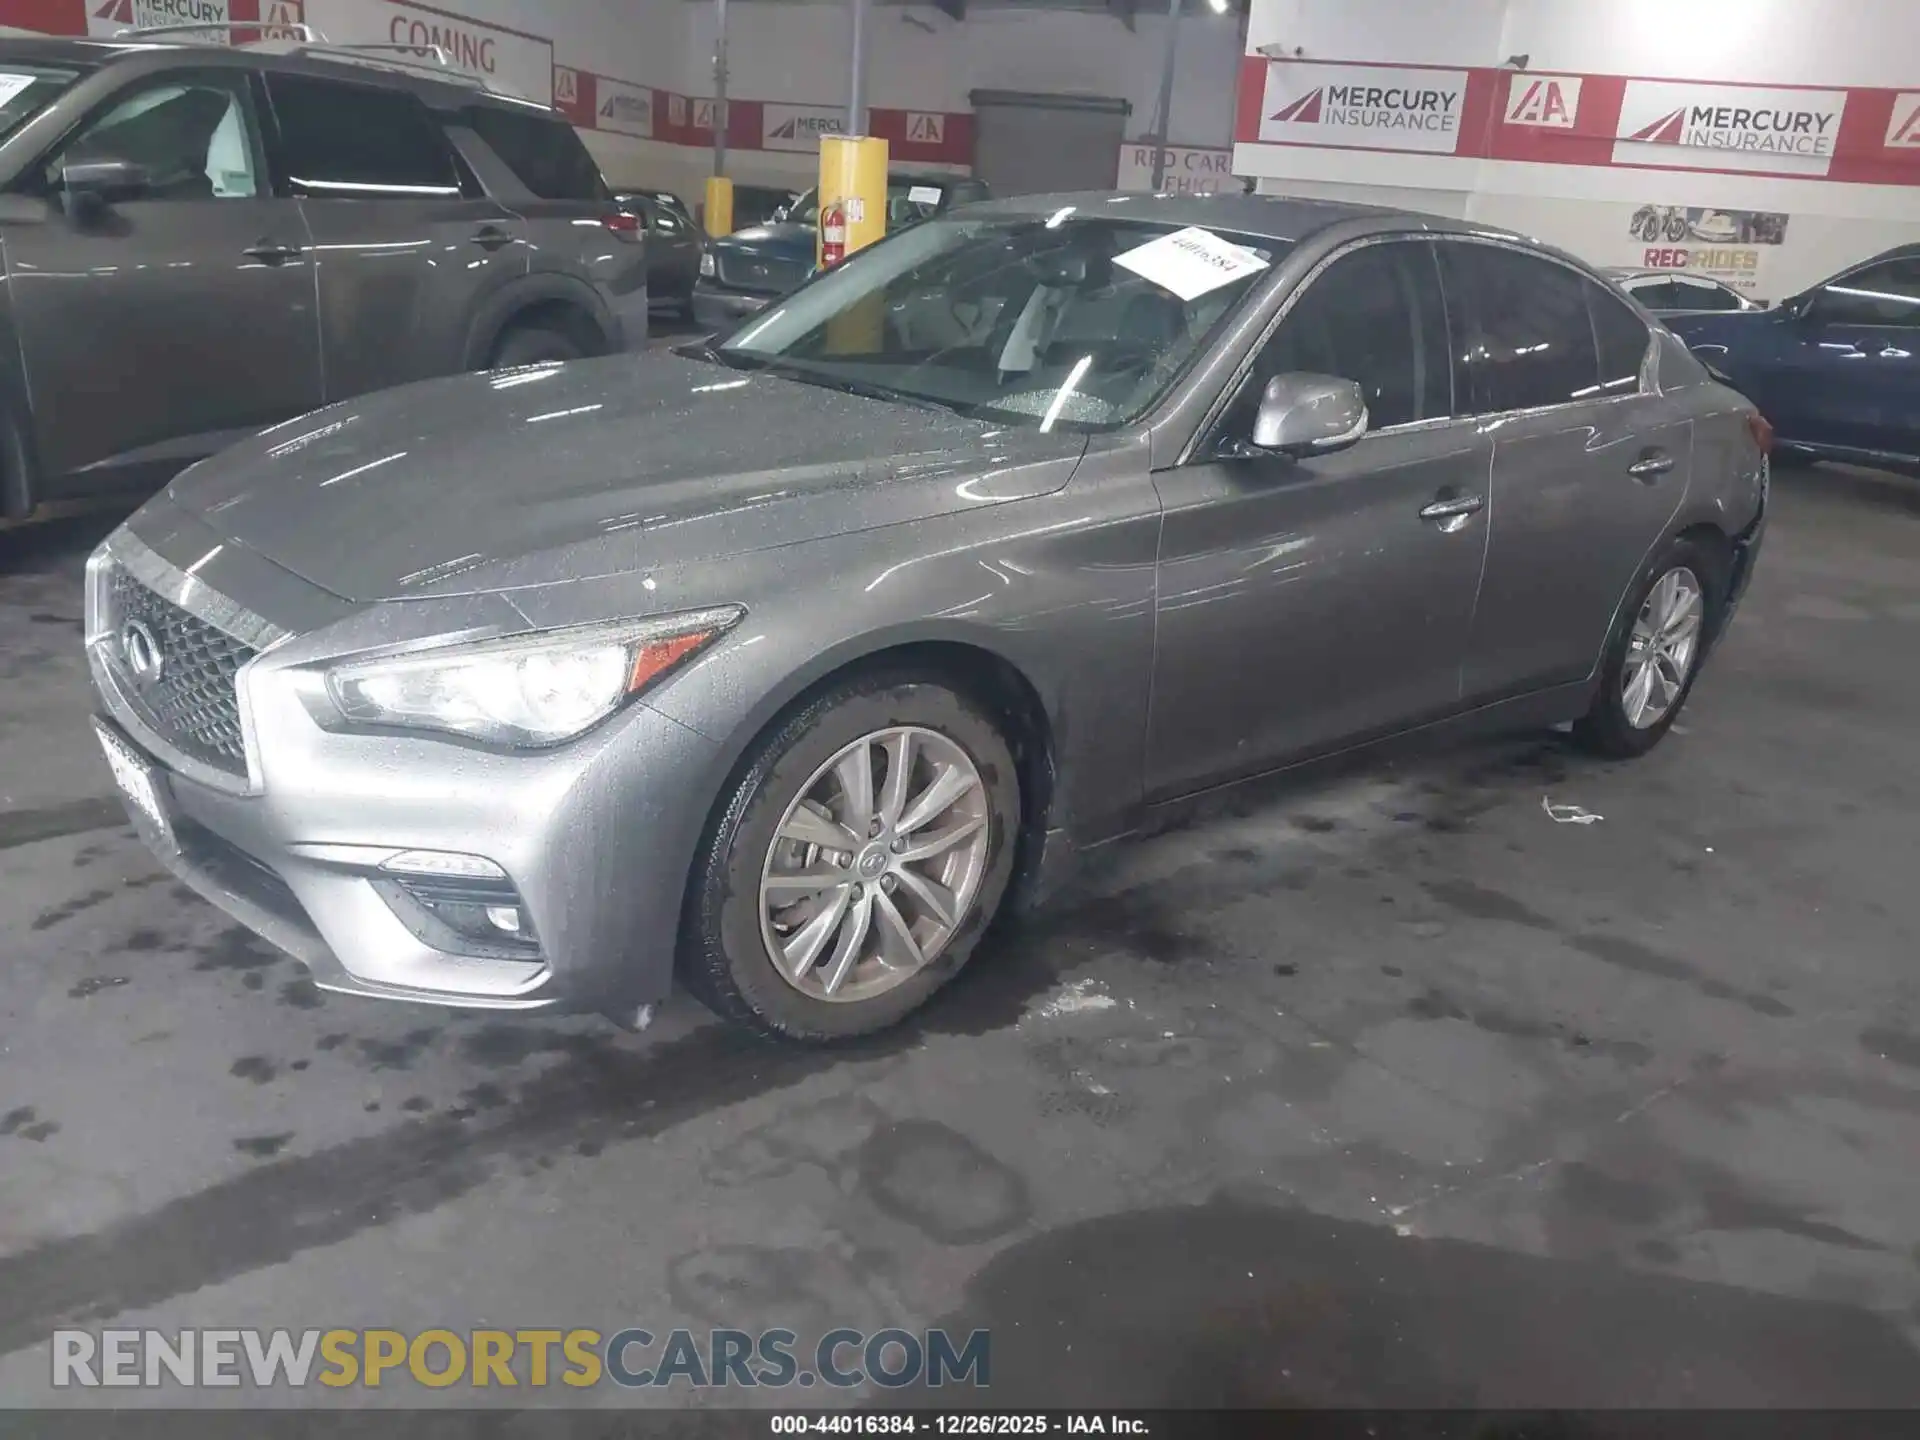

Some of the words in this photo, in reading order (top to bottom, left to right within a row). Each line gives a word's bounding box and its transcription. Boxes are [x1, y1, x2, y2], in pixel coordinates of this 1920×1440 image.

[390, 15, 496, 73] COMING
[1328, 85, 1457, 112] MERCURY
[1324, 107, 1454, 131] INSURANCE
[1690, 106, 1834, 133] MERCURY
[1687, 129, 1830, 153] INSURANCE
